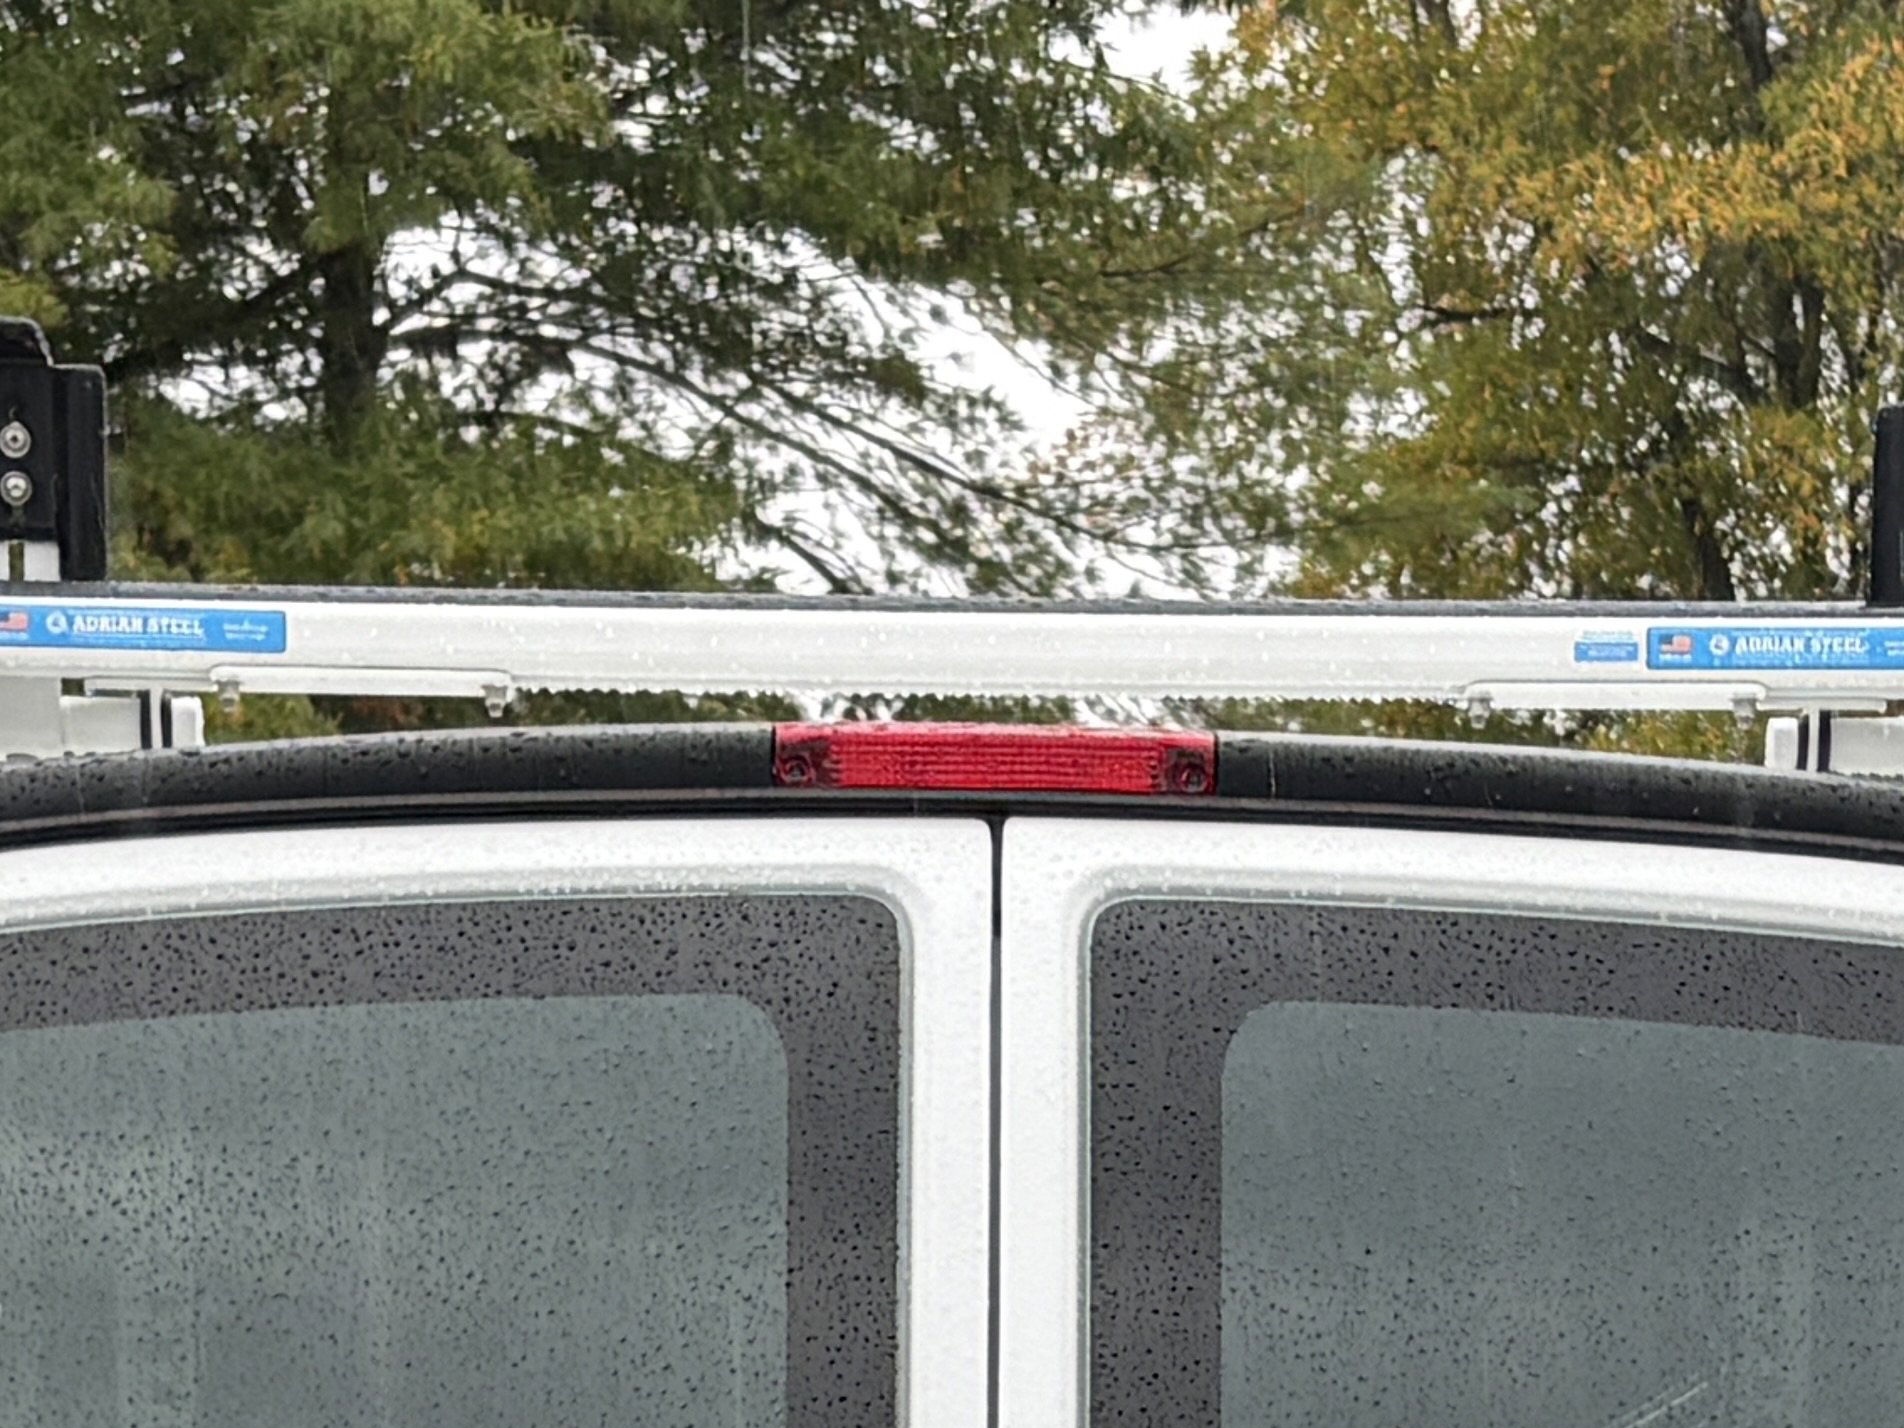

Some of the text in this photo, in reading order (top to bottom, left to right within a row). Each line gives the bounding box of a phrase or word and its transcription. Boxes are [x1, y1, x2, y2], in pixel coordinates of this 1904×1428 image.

[73, 615, 143, 635] ADRIAN
[146, 618, 204, 638] STEEL
[1734, 635, 1805, 656] ADRIAN
[1810, 635, 1868, 655] STEEL
